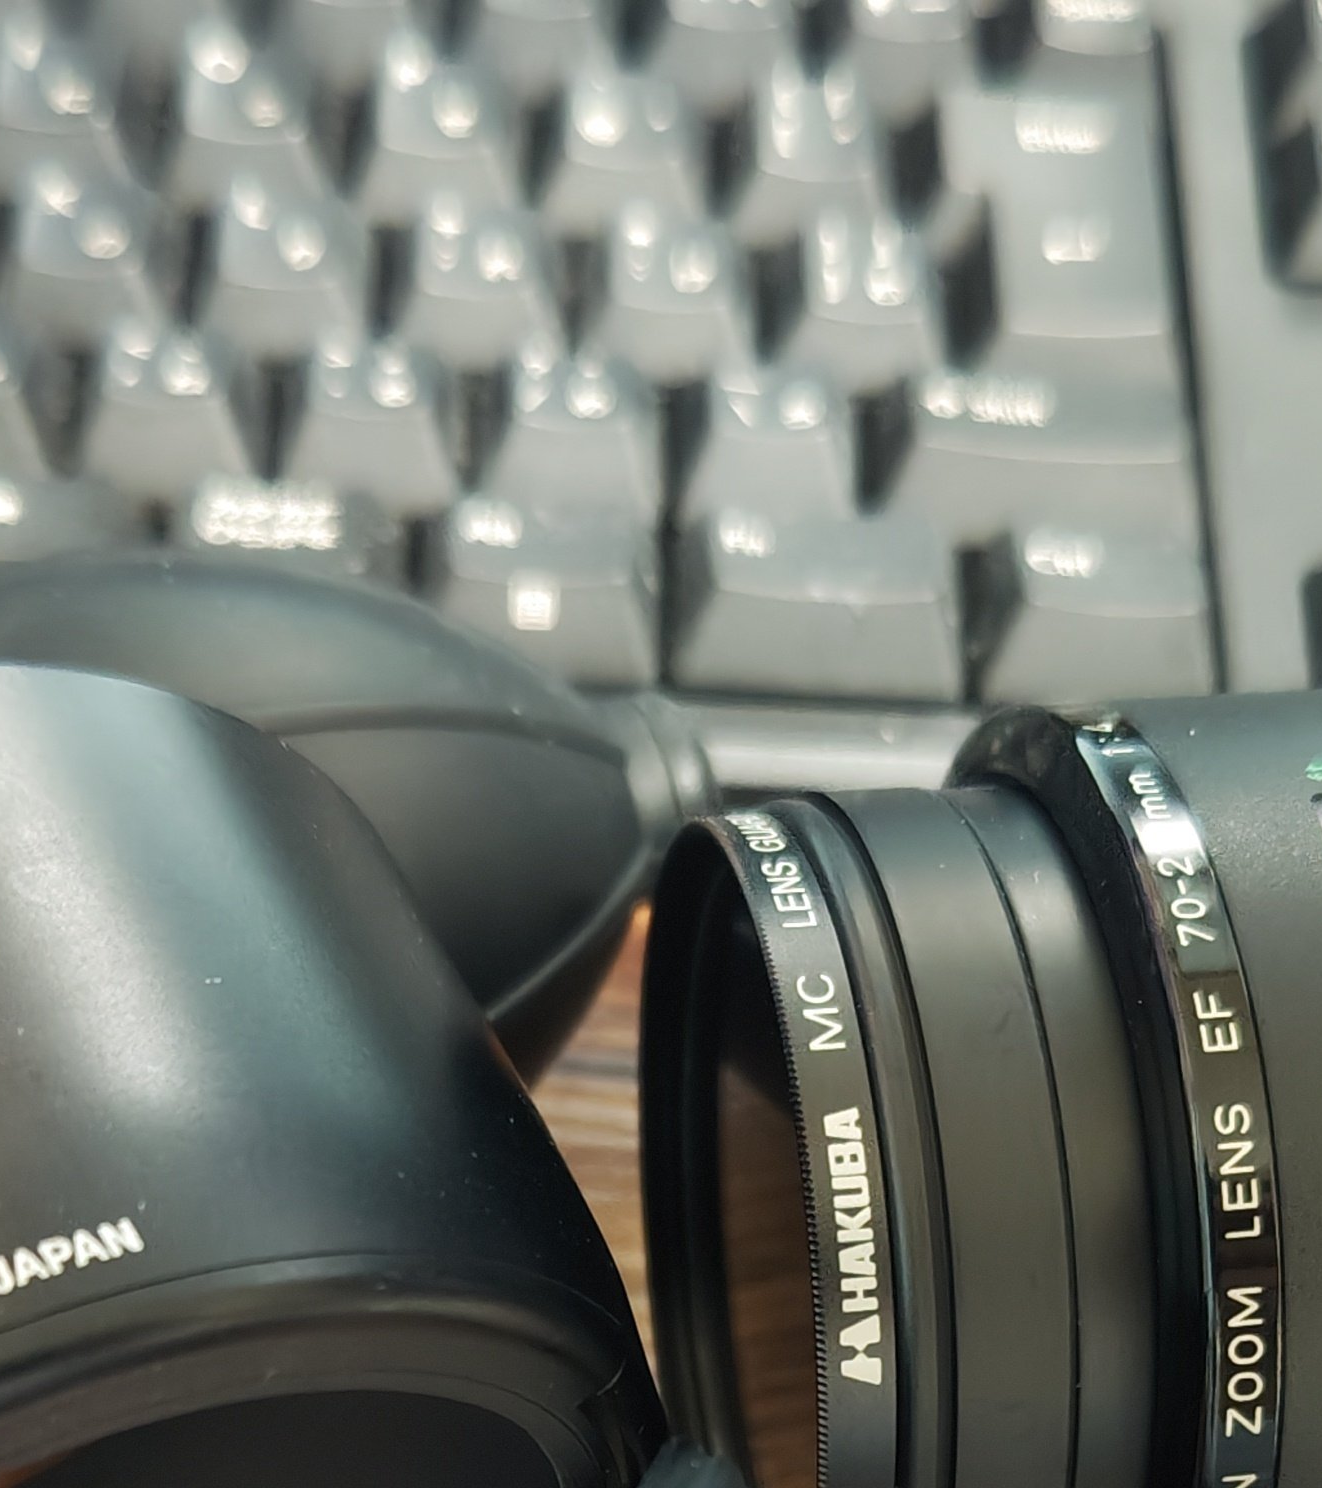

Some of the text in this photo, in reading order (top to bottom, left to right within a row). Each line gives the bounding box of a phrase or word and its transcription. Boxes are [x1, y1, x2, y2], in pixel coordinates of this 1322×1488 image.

[760, 861, 818, 928] LENS
[795, 973, 847, 1052] MC
[1192, 990, 1240, 1054] EF
[823, 1107, 880, 1312] HAKUBA
[1213, 1102, 1262, 1241] LENS
[1225, 1286, 1265, 1438] ZOOM
